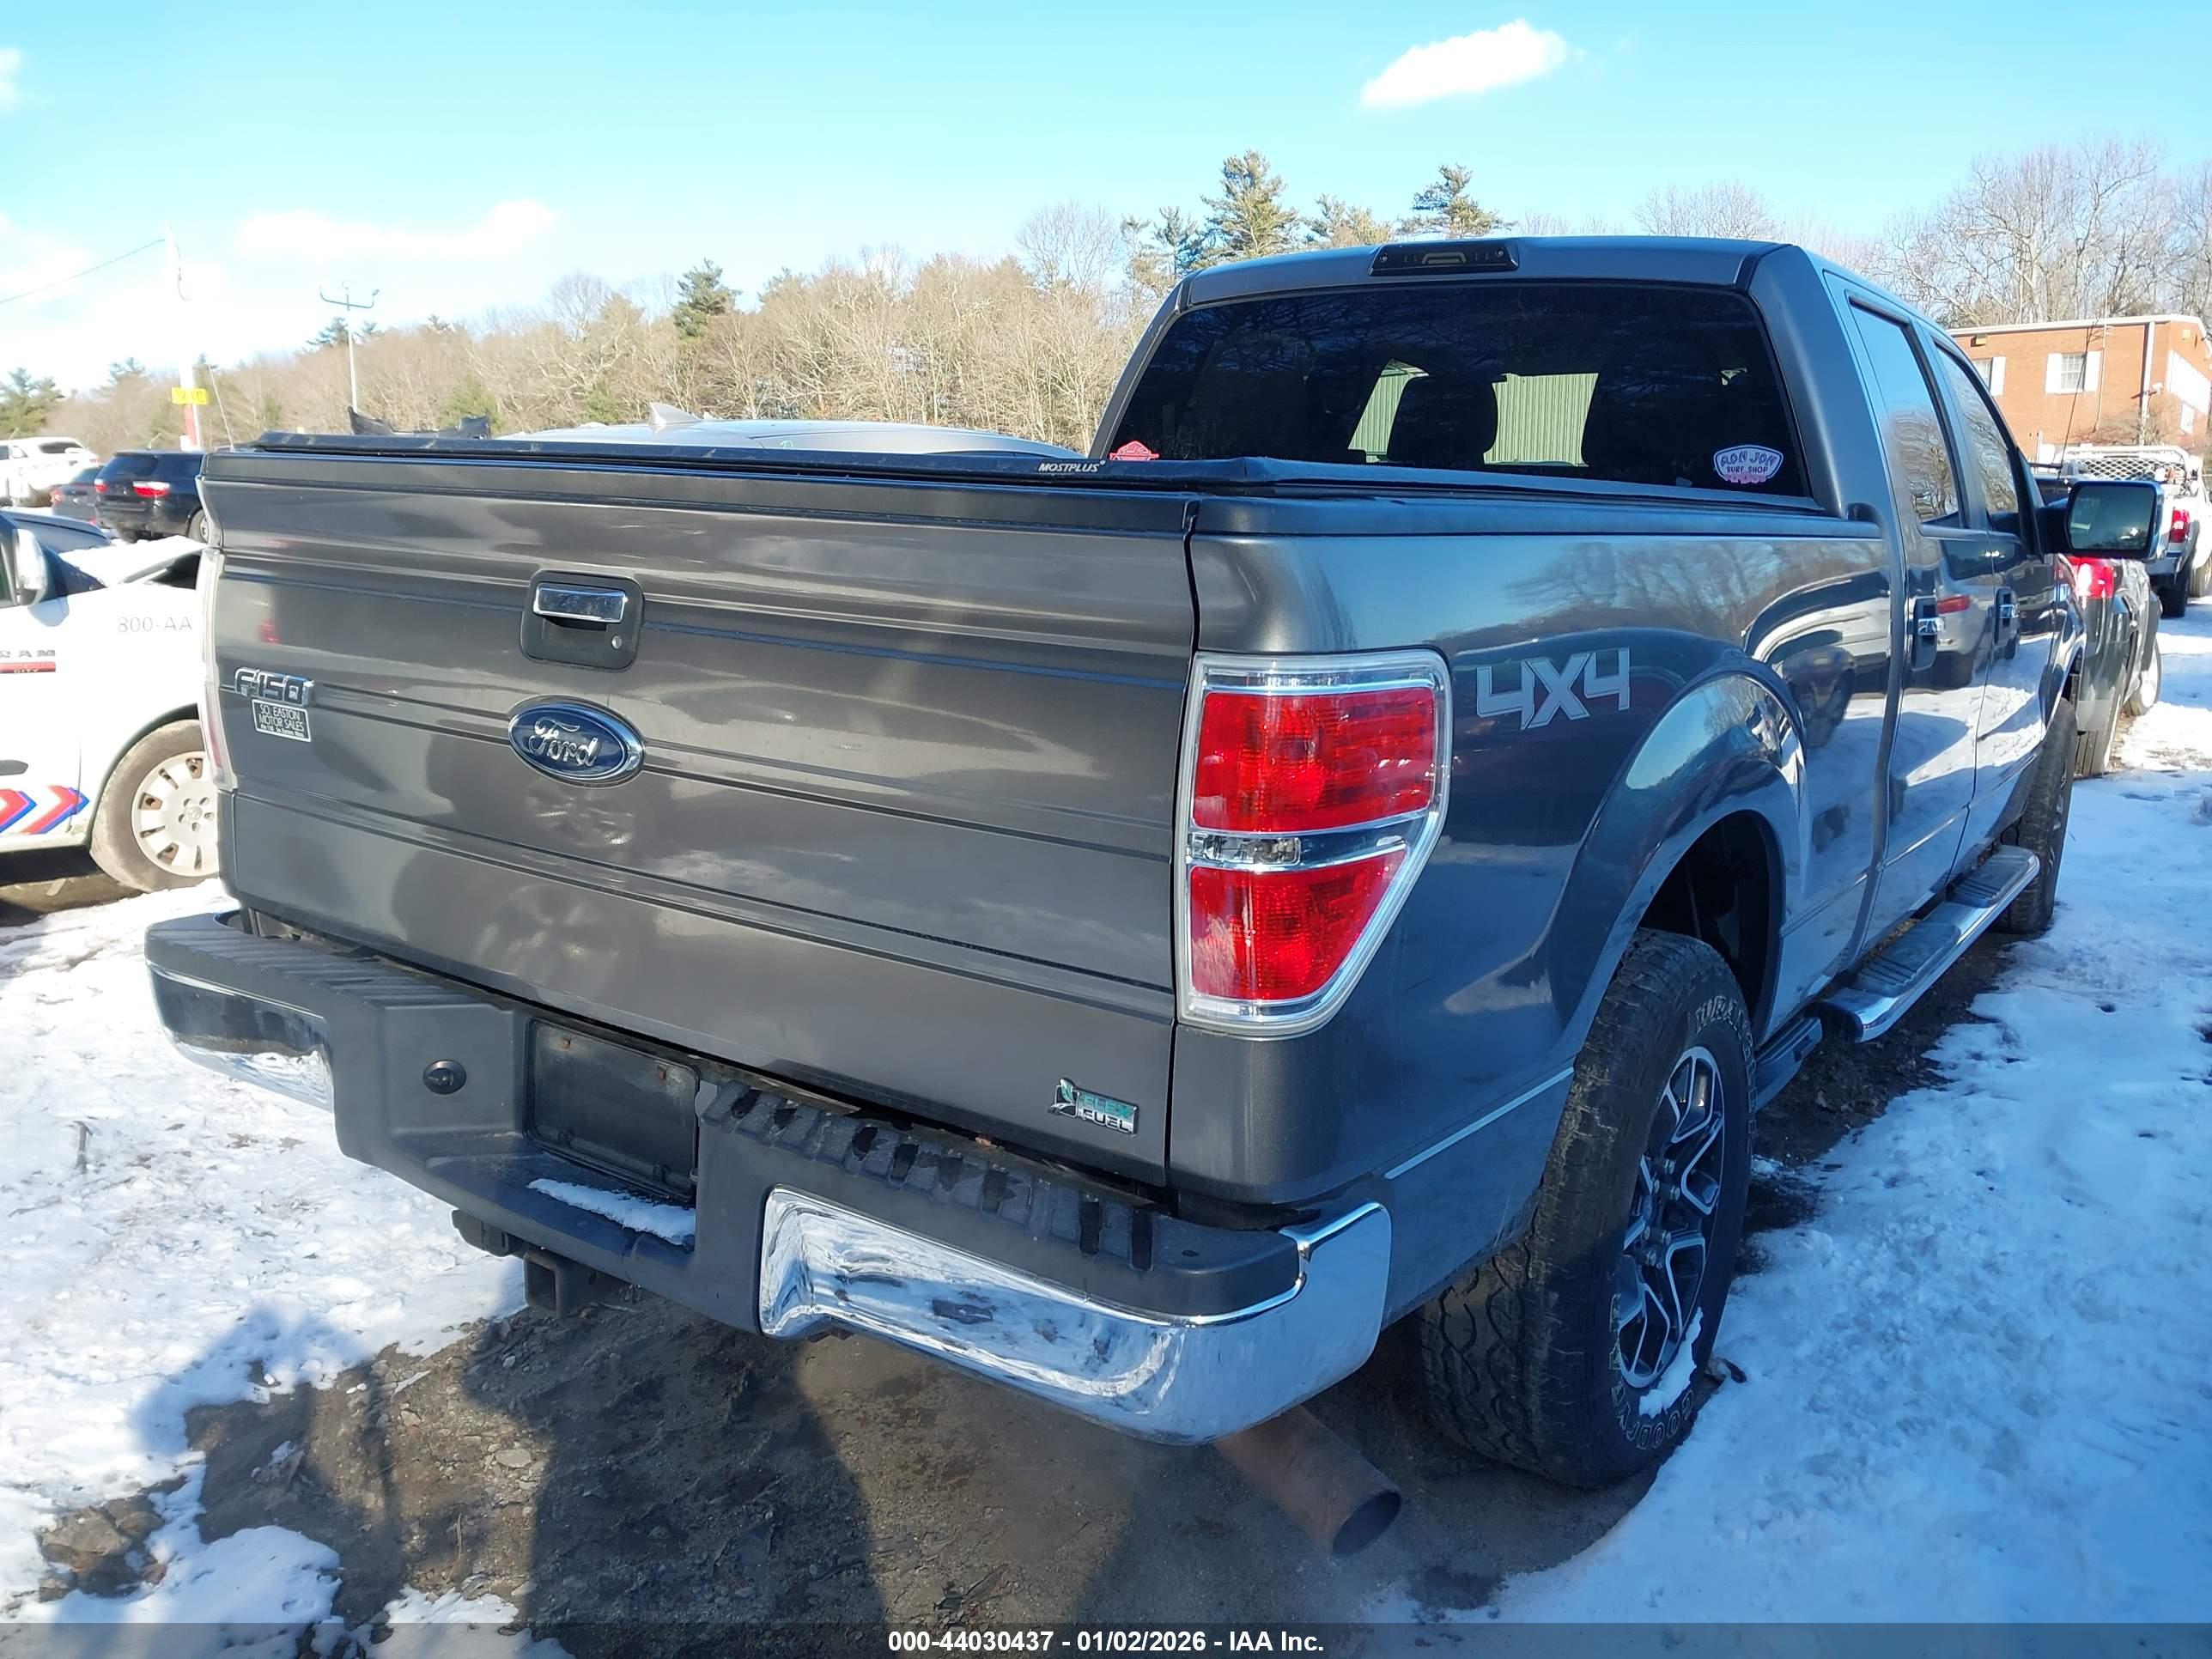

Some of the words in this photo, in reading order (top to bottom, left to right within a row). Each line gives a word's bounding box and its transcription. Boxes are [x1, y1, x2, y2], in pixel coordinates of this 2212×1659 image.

[1721, 451, 1748, 467] RON
[1749, 452, 1778, 467] JON
[1038, 462, 1100, 473] MOSTPLUS
[1727, 465, 1745, 474] SURF
[1748, 465, 1769, 474] SHOP
[118, 617, 193, 633] 800-AA
[1476, 647, 1631, 730] 4X4
[272, 706, 301, 721] EASTON
[258, 714, 283, 728] MOTOR
[283, 719, 305, 732] SALES
[528, 716, 600, 767] Ford
[1082, 1108, 1130, 1133] FUEL
